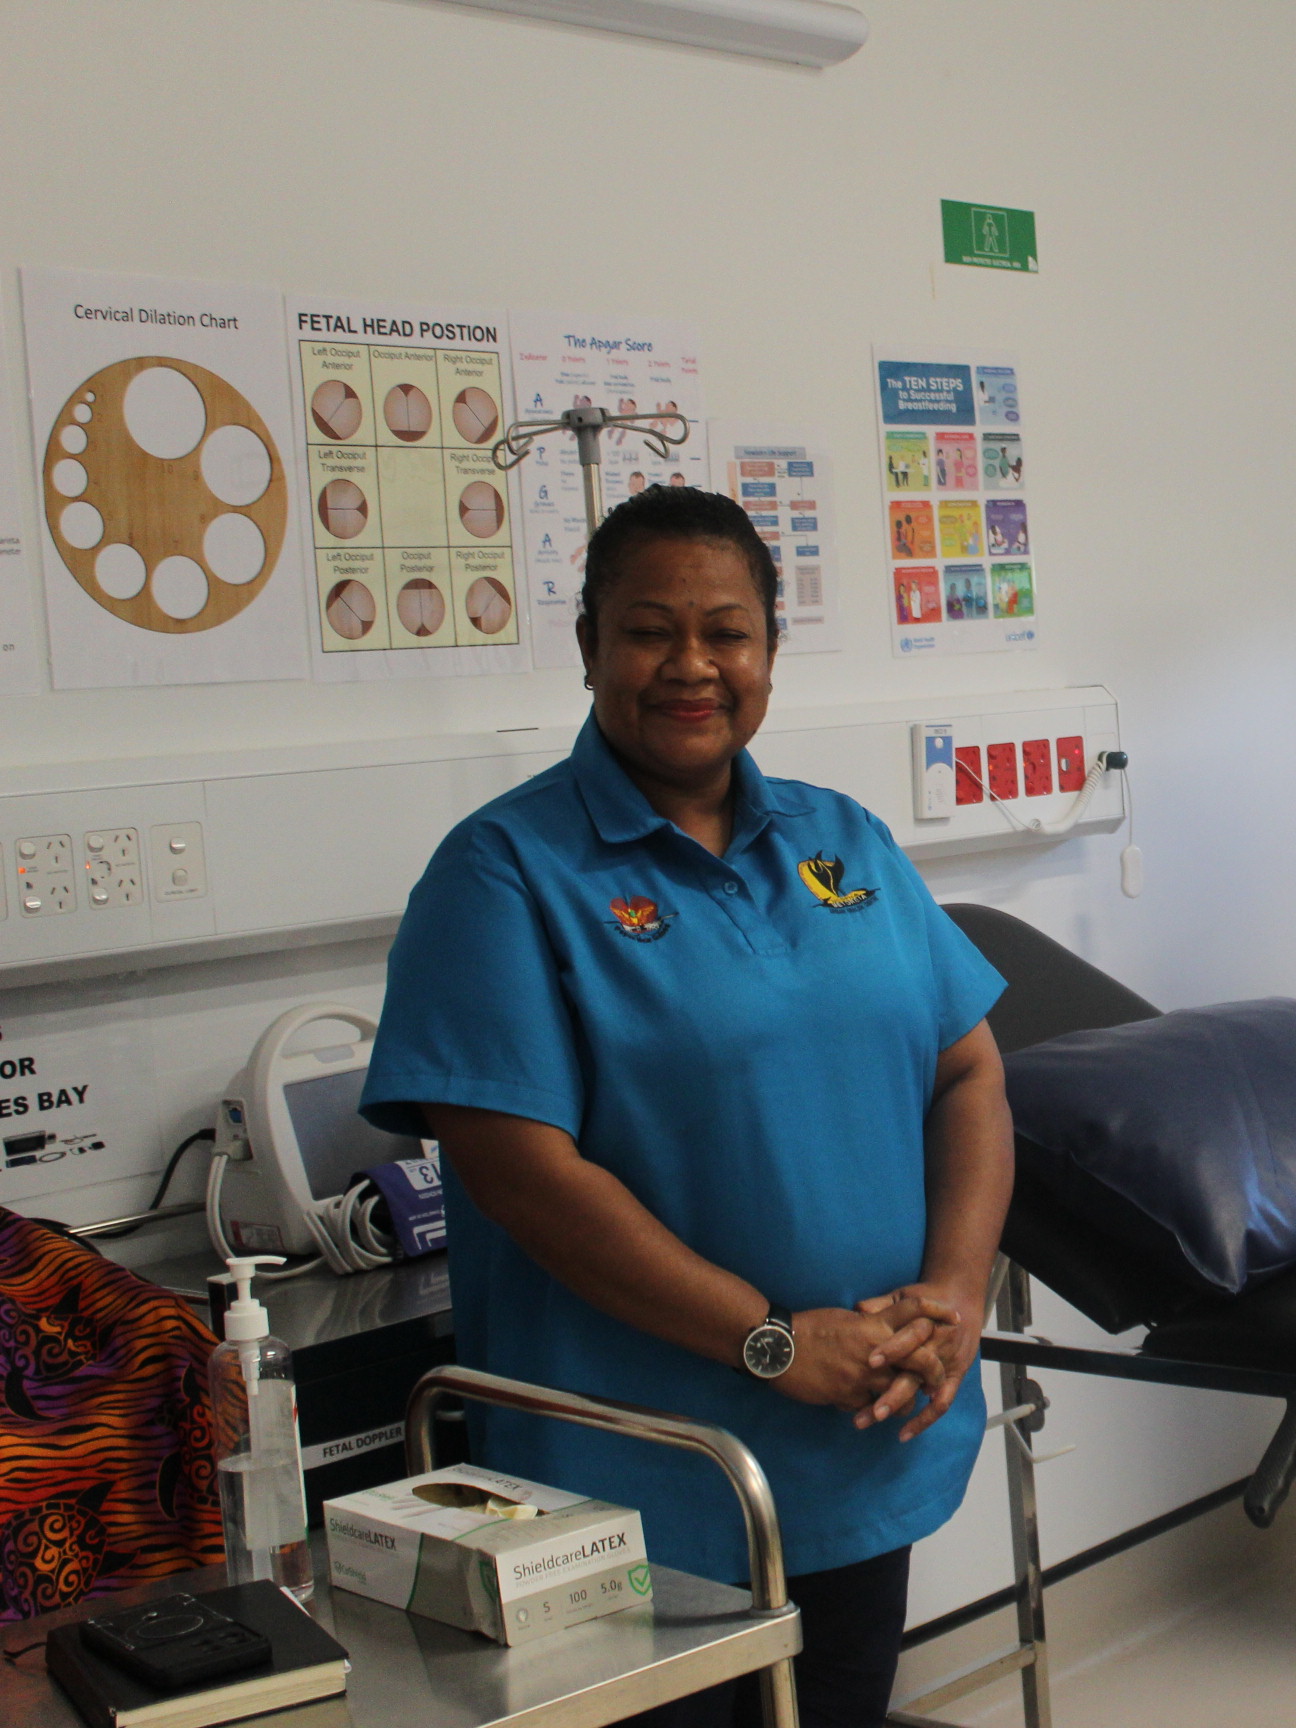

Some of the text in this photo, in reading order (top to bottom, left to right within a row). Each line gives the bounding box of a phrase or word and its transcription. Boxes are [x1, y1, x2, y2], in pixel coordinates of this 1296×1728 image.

[74, 304, 239, 330] Cervical Dilation Chart
[298, 313, 497, 343] FETAL HEAD POSTION
[563, 334, 653, 355] The Apgar Score
[312, 346, 361, 360] Left Occiput
[373, 350, 434, 362] Occiput Anterior
[322, 360, 354, 371] Anterior
[443, 354, 494, 367] Right Occiput
[455, 367, 484, 378] Anterior
[887, 376, 964, 391] The TEN STEPS
[533, 393, 544, 408] A
[898, 389, 954, 400] to Successful
[898, 400, 957, 413] Breastfeeding
[318, 450, 366, 461] Left Occiput
[450, 453, 470, 465] Right
[320, 463, 366, 473] Transverse
[455, 466, 496, 476] Transverse
[542, 533, 552, 549] A
[326, 553, 374, 563] Left Occiput
[401, 551, 431, 562] Occiput
[456, 551, 505, 562] Right Occiput
[333, 565, 369, 575] Posterior
[400, 564, 435, 574] Posterior
[465, 563, 498, 573] Posterior
[543, 581, 557, 596] R
[0, 1057, 36, 1080] OR
[38, 1084, 89, 1112] BAY
[322, 1426, 402, 1458] FETAL DOPPLER
[329, 1518, 396, 1551] ShieldcareLATEX
[513, 1532, 627, 1581] ShieldcareLATEX
[569, 1589, 587, 1605] 100
